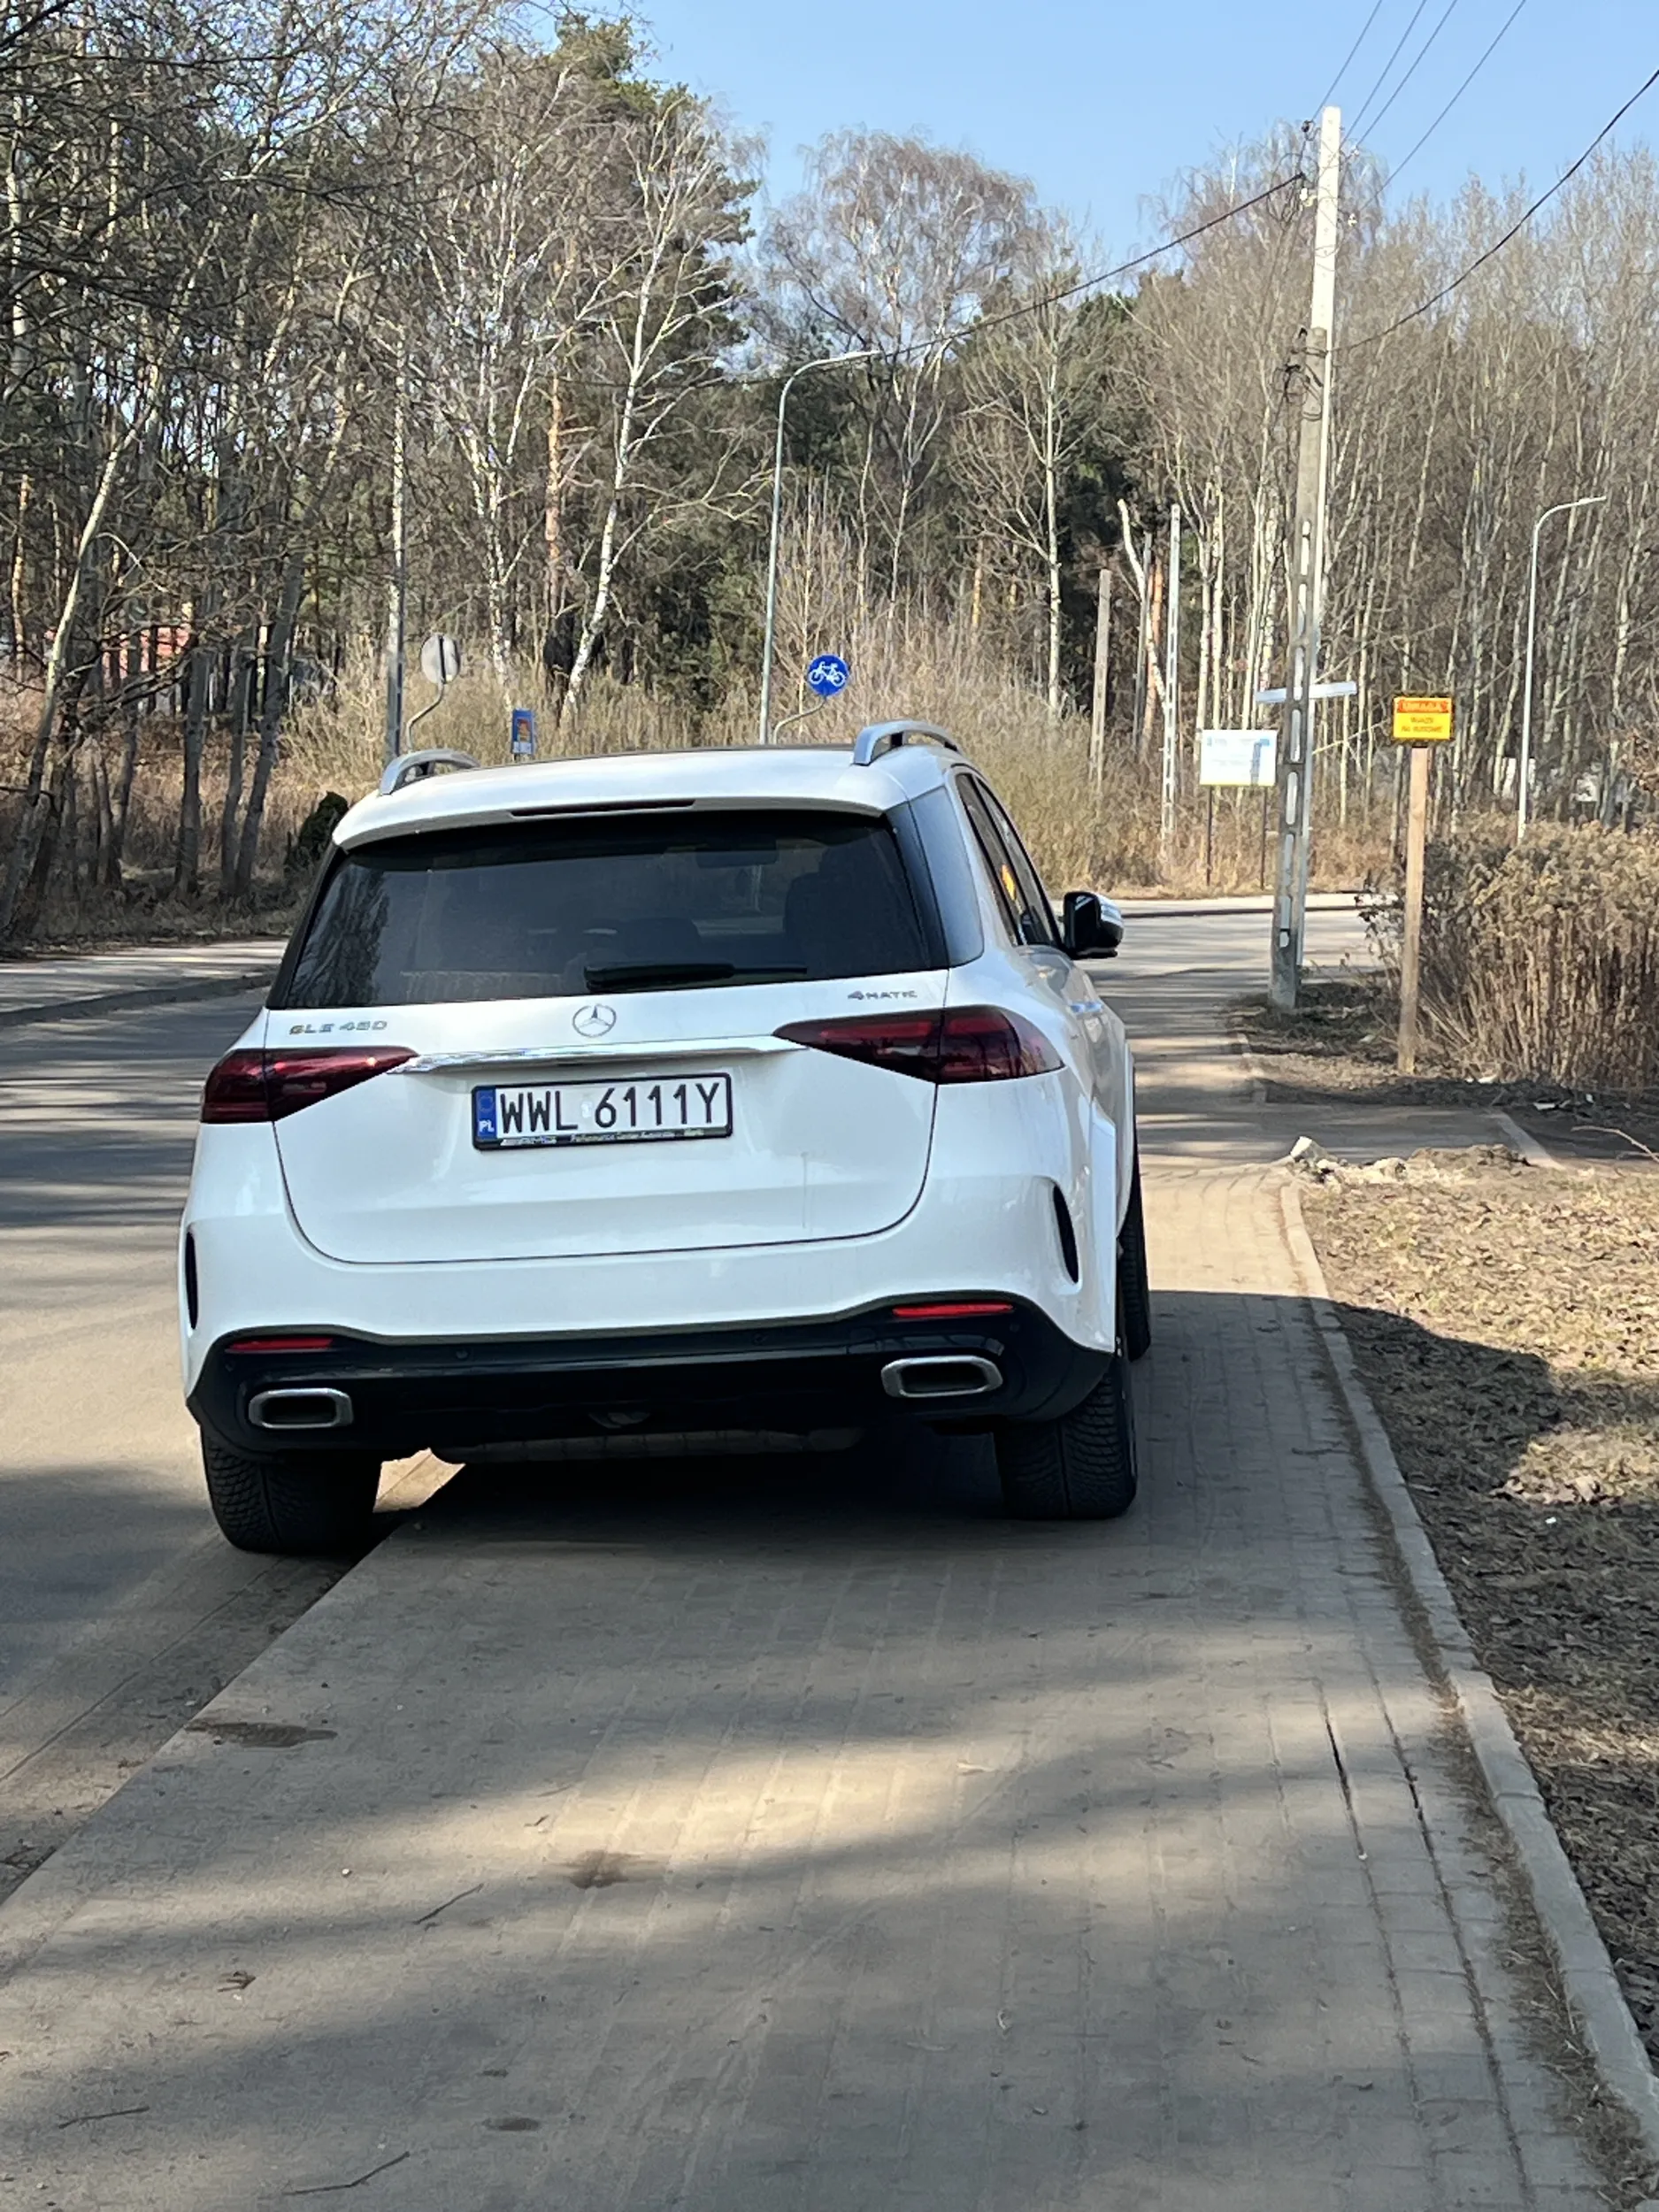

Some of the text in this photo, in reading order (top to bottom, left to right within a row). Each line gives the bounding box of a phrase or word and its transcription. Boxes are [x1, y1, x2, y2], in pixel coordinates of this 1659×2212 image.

[288, 1023, 335, 1035] GLE
[500, 1082, 720, 1134] WWL 6111Y
[479, 1119, 495, 1133] PL
